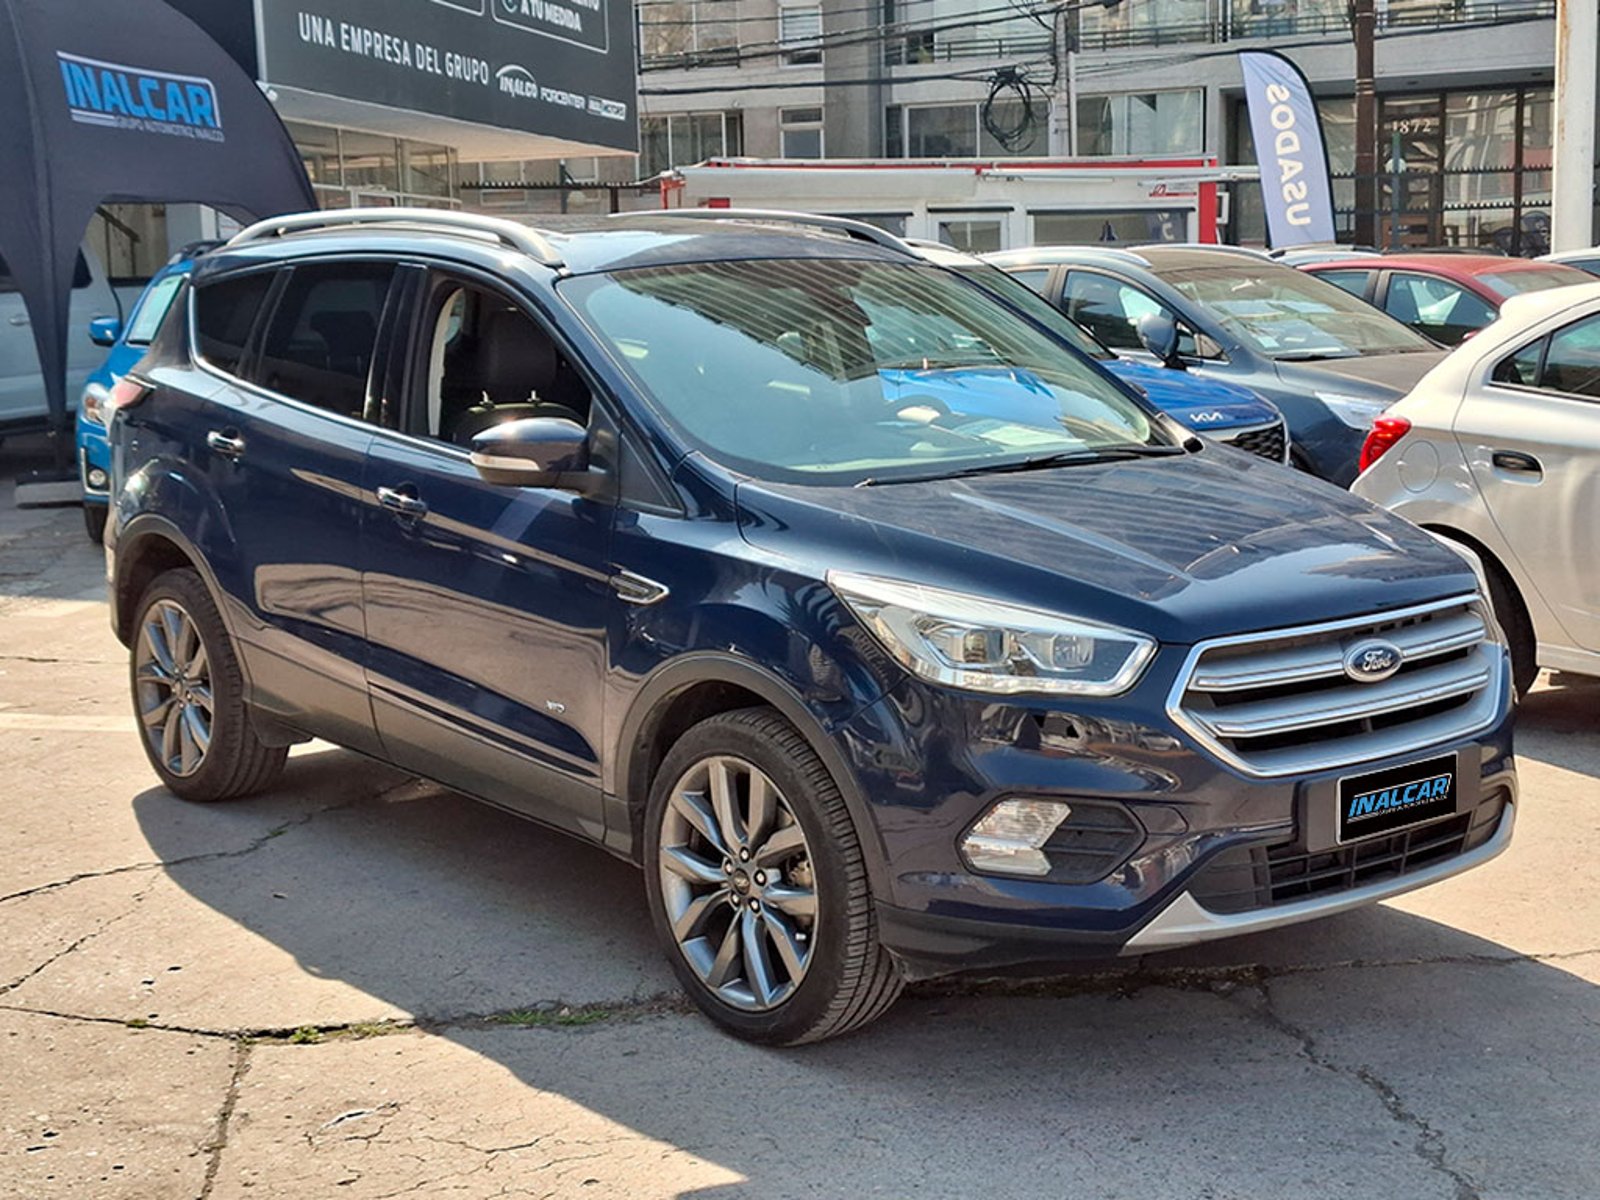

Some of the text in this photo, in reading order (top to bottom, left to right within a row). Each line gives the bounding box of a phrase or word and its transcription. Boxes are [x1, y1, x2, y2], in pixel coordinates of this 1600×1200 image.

[544, 2, 582, 33] MEDIDA
[298, 12, 489, 86] UNA EMPRESA DEL GRUPO
[59, 59, 216, 128] INALCAR
[1361, 649, 1393, 672] Ford
